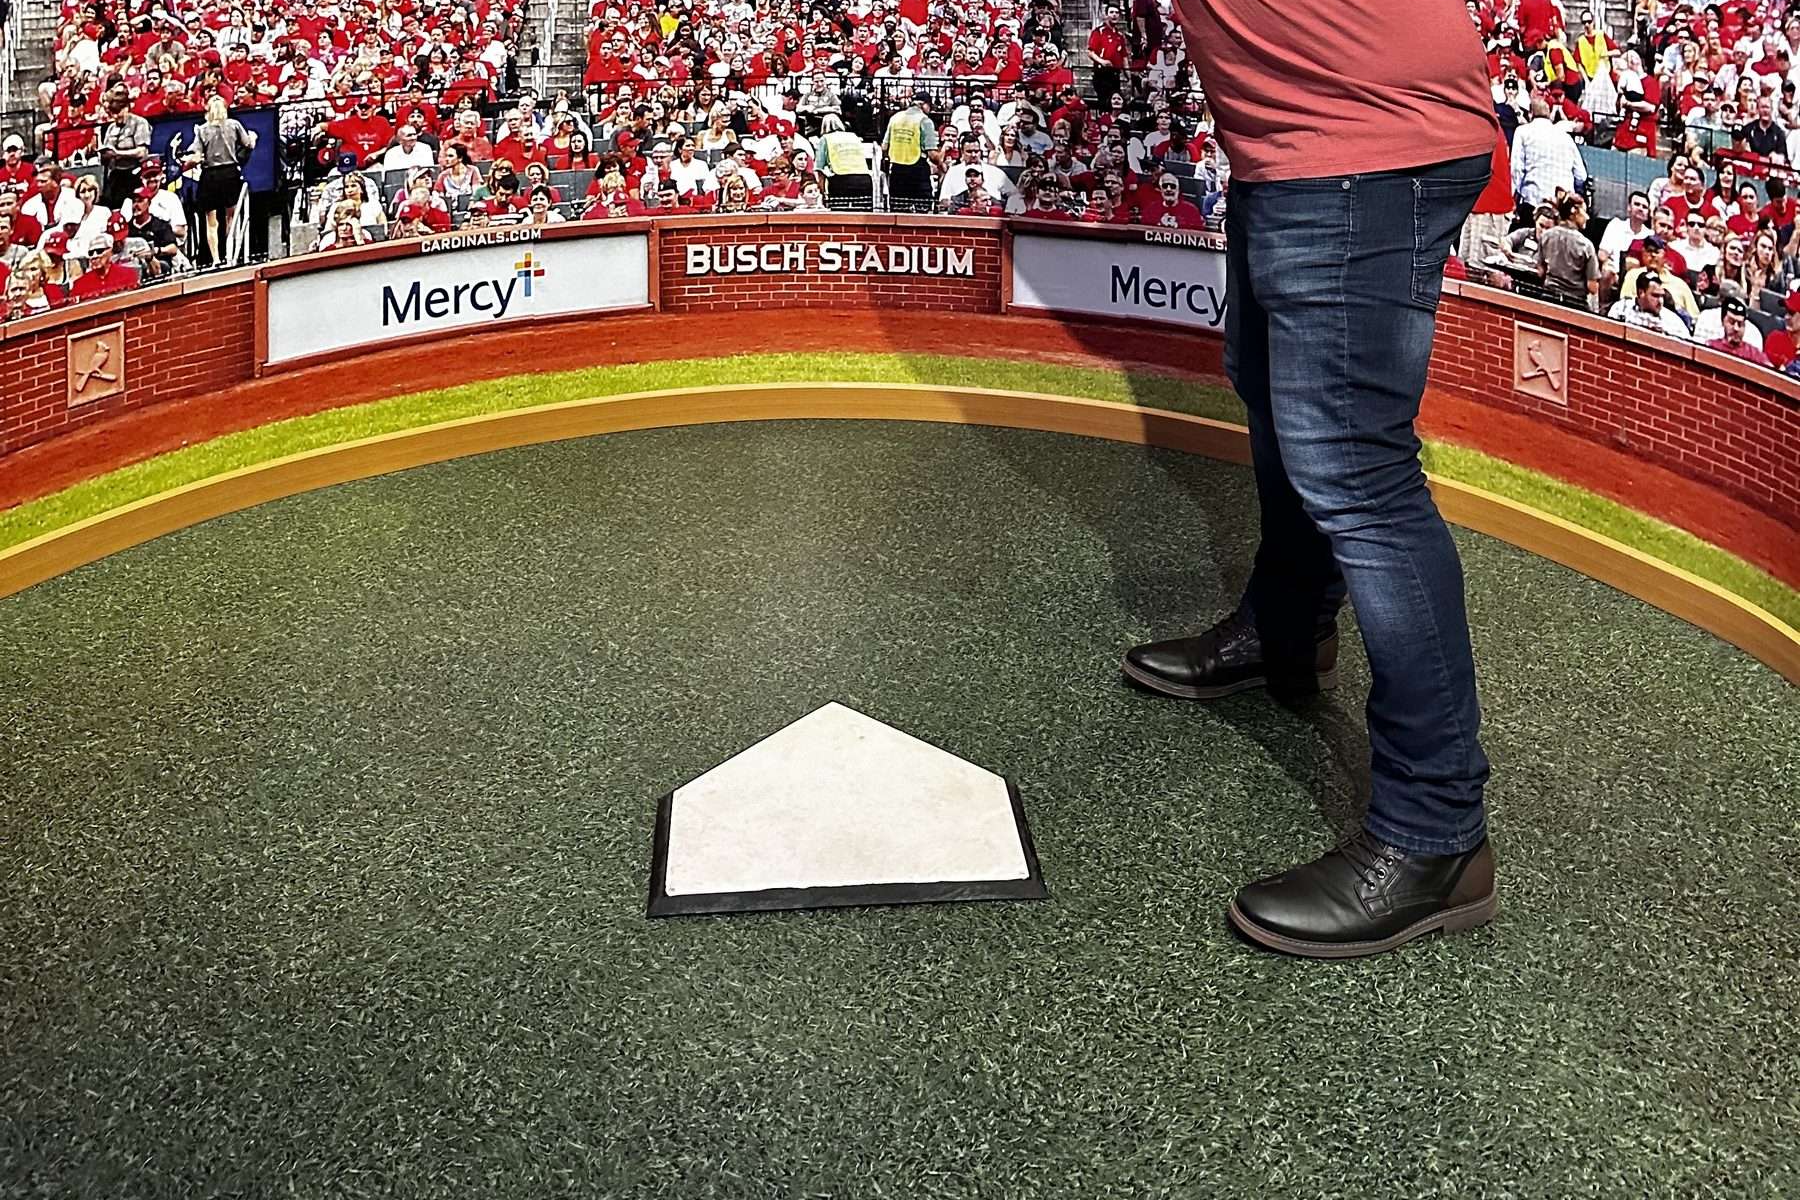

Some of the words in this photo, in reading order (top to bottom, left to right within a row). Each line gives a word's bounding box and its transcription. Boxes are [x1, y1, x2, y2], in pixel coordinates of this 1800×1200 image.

[421, 228, 542, 252] CARDINALS.COM
[686, 242, 808, 275] BUSCH
[818, 241, 975, 276] STADIUM
[382, 277, 518, 326] Mercy
[1111, 264, 1228, 327] Mercy
